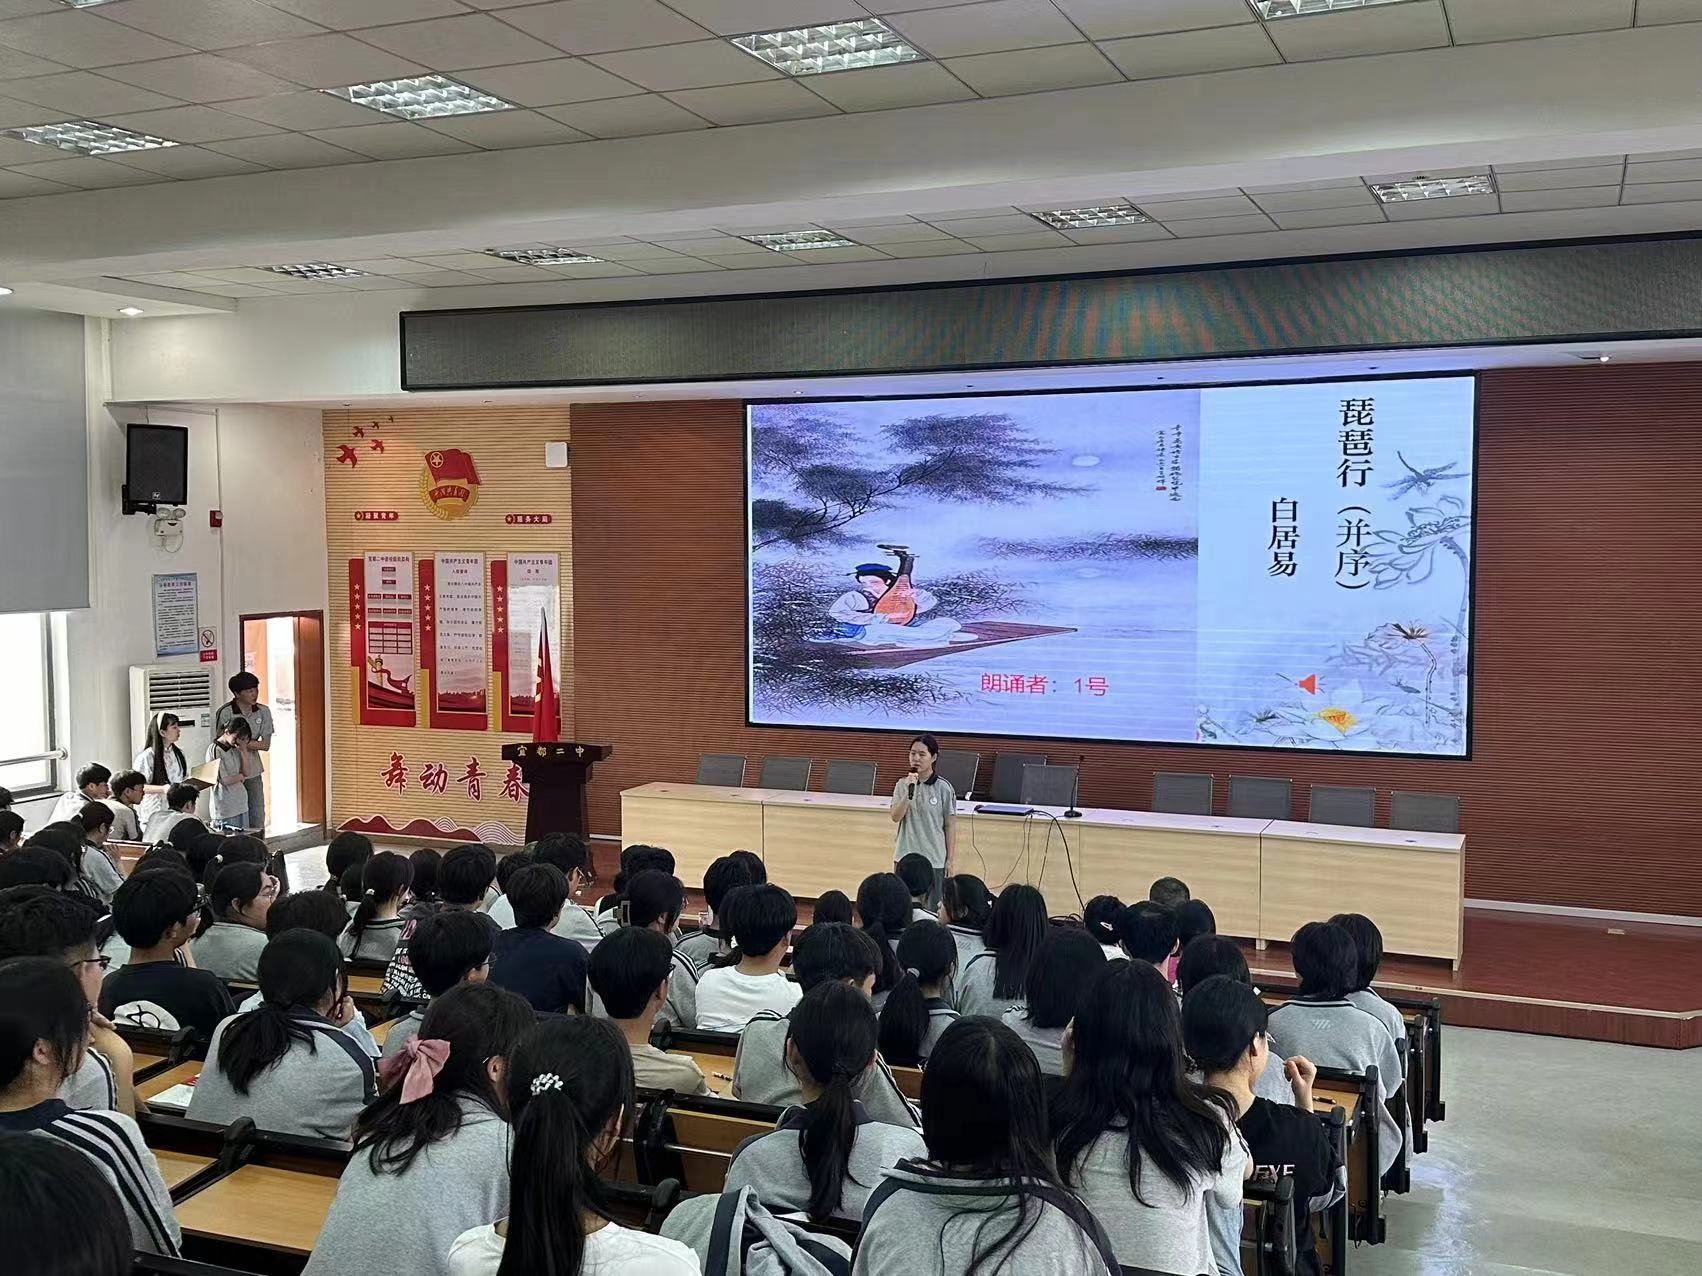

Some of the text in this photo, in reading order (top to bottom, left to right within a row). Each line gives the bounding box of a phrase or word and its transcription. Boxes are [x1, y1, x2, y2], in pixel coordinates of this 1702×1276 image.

[1334, 397, 1375, 590] 琵琶行（并序）
[1267, 497, 1300, 577] 白居易
[981, 673, 1109, 697] 朗诵者：1号
[381, 751, 529, 801] 舞动青春
[517, 745, 585, 758] 宜都二中
